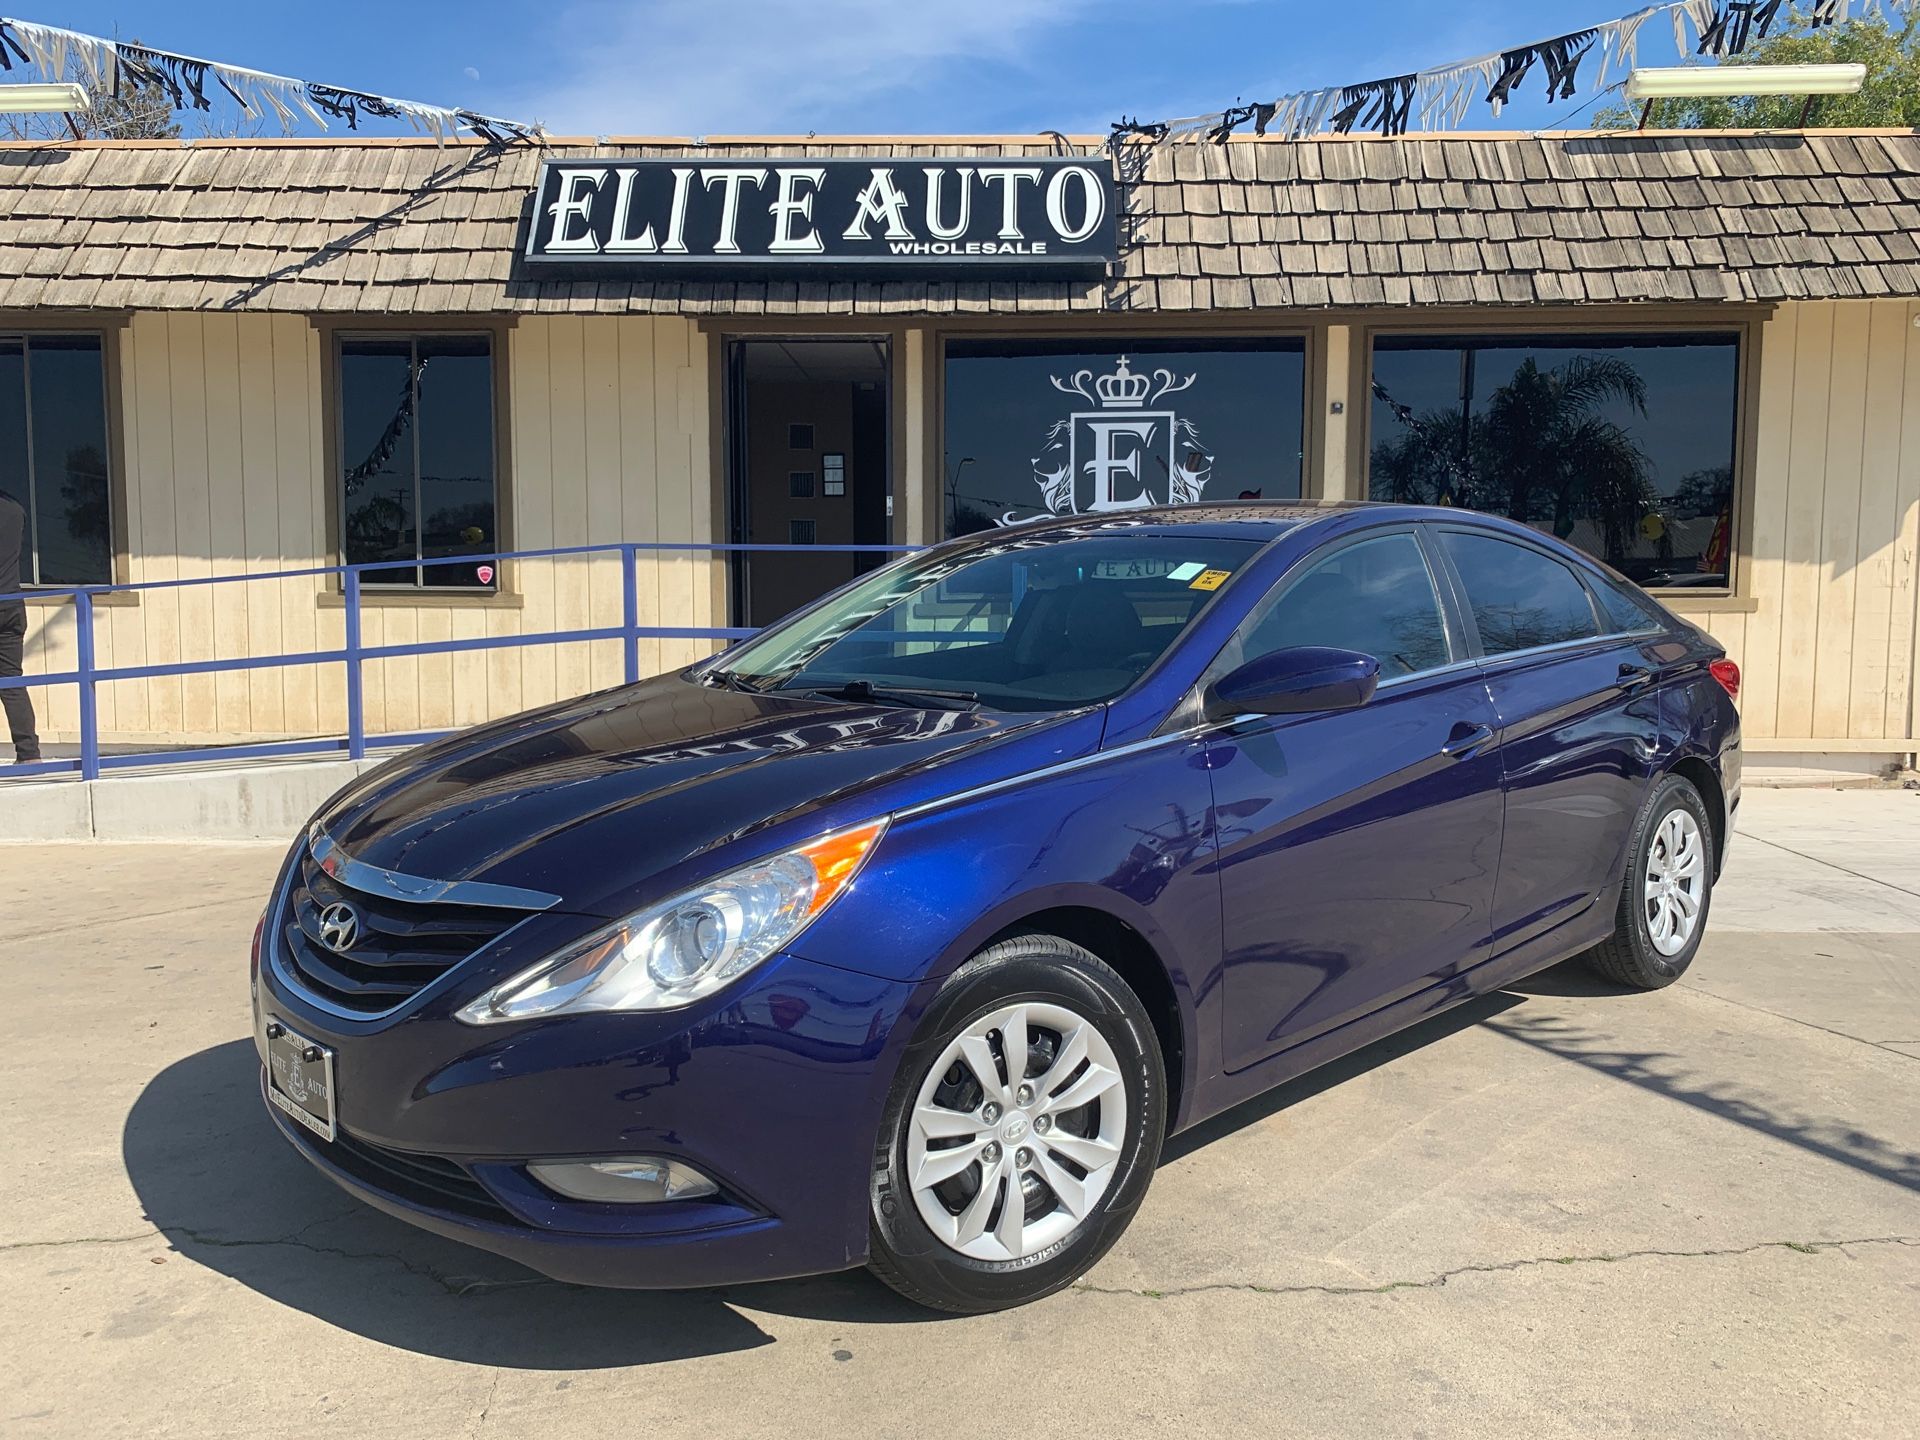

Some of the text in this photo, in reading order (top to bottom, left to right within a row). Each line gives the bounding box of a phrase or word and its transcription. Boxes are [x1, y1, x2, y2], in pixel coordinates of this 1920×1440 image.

[545, 166, 1105, 253] ELITE AUTO
[889, 241, 1047, 255] WHOLESALE
[1082, 422, 1157, 512] E
[271, 1051, 287, 1073] ELITE
[307, 1077, 328, 1100] AUTO
